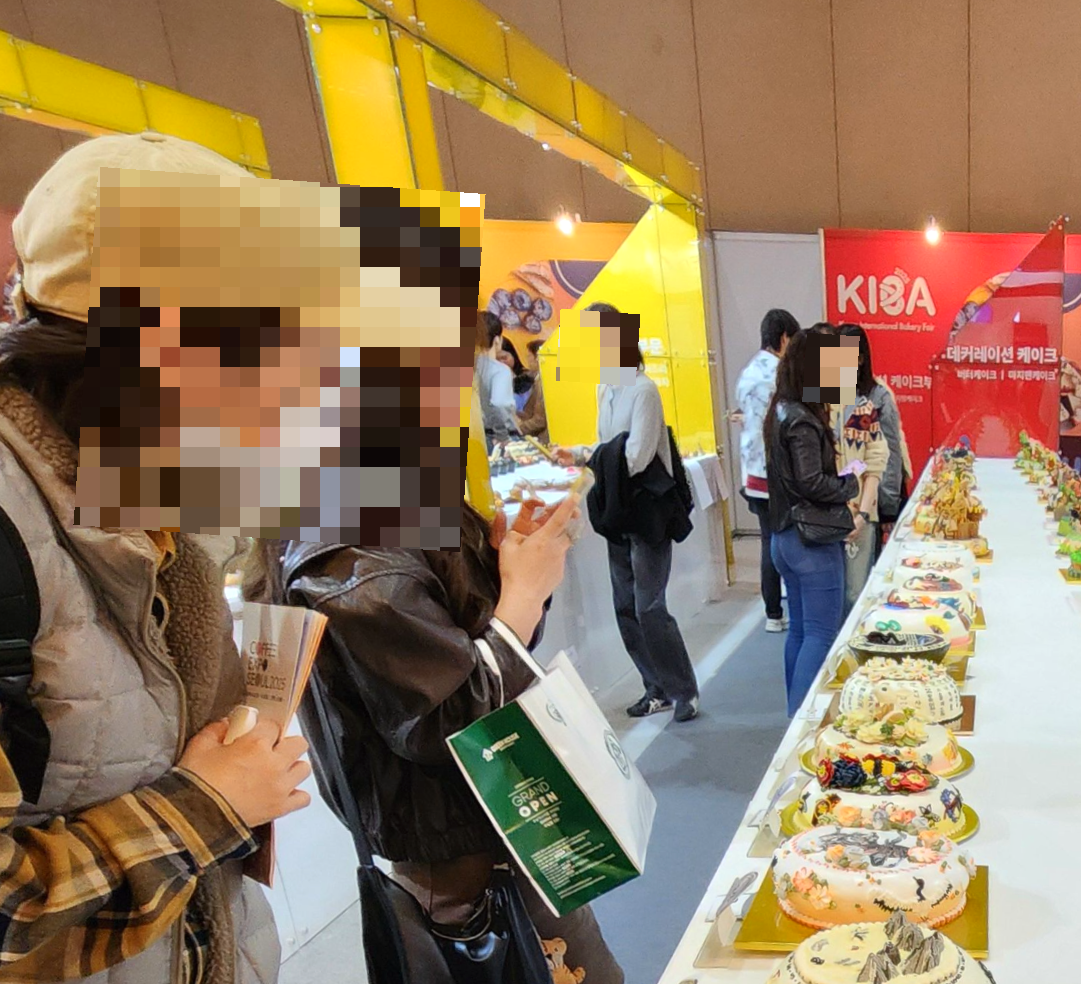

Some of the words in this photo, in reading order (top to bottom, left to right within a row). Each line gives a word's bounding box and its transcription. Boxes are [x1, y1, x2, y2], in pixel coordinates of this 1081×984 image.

[837, 274, 936, 316] KIBA
[946, 345, 1014, 364] 데커레이션
[1017, 346, 1059, 364] 케이크
[512, 782, 550, 807] GRAND
[519, 791, 558, 818] OPEN
